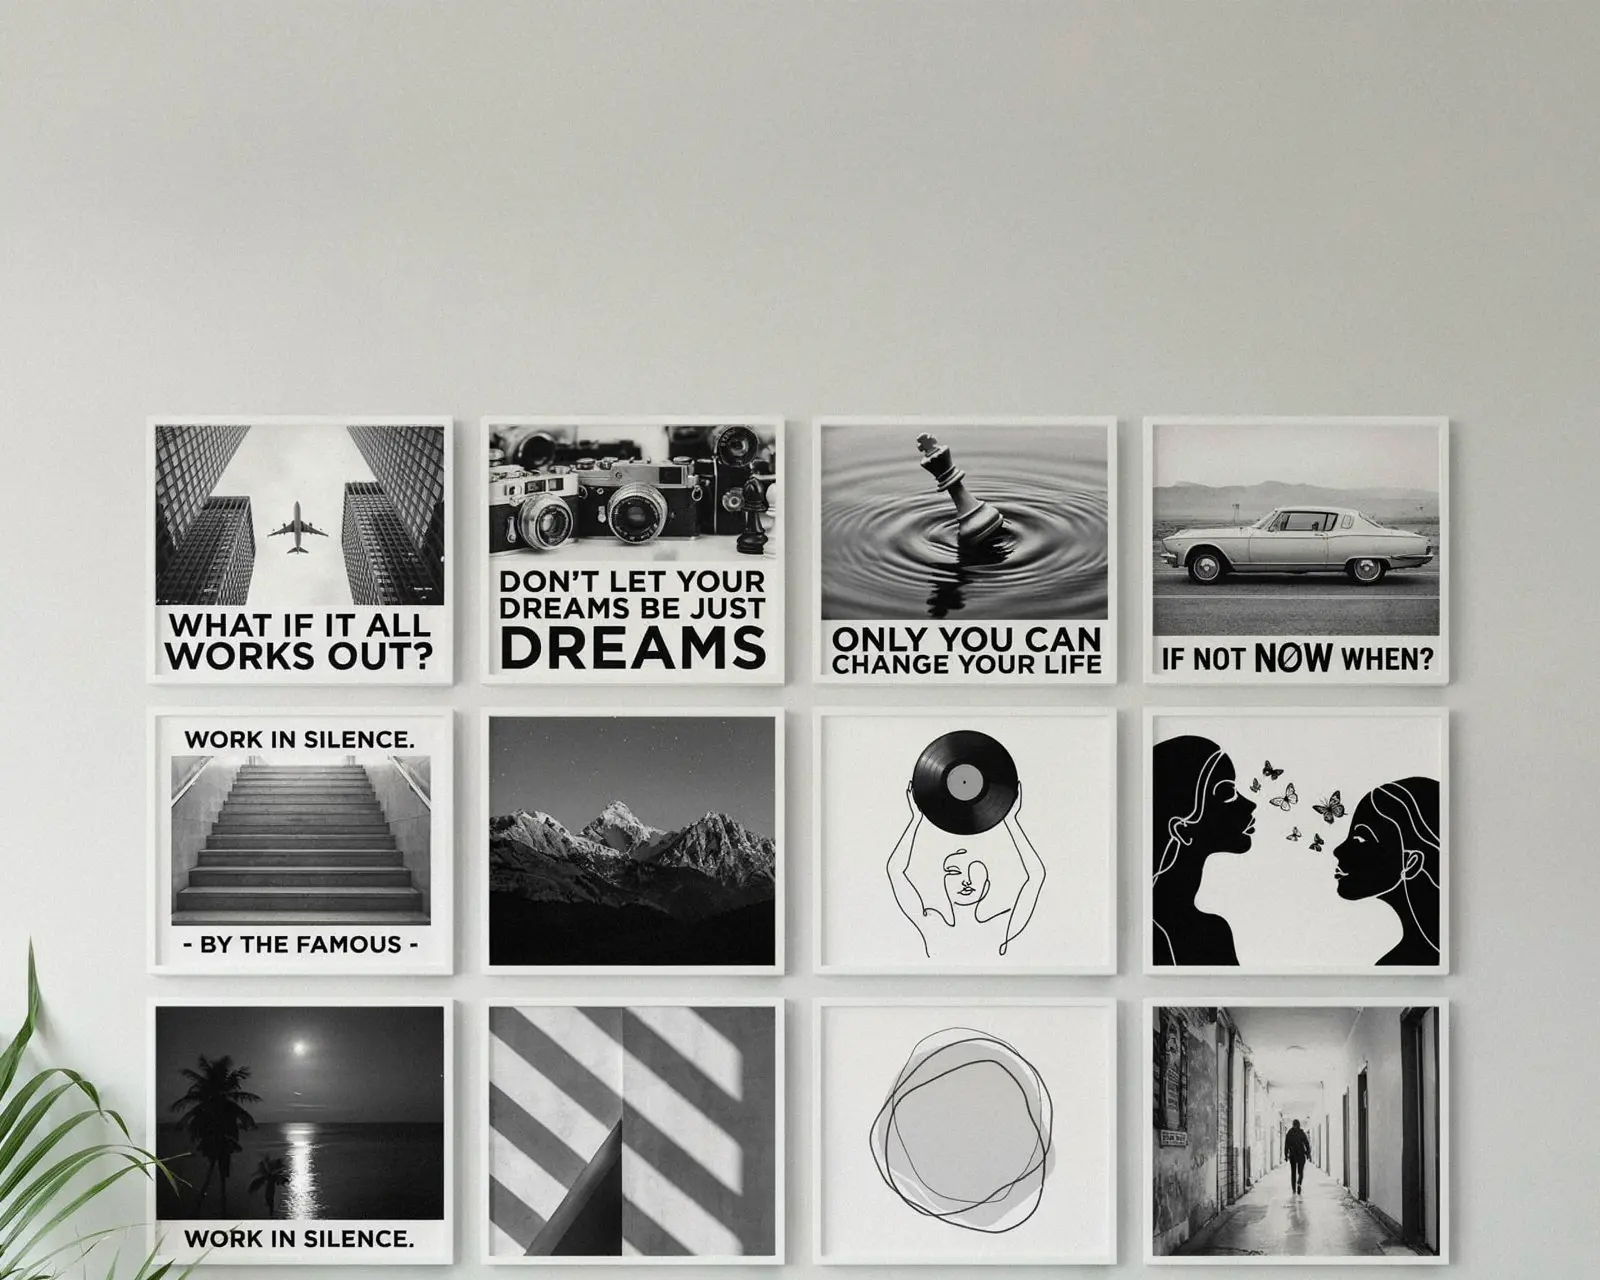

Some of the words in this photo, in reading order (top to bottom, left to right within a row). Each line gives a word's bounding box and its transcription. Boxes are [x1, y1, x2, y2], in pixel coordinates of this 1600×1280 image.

[611, 570, 666, 593] LET
[677, 570, 765, 593] YOUR
[500, 598, 629, 620] DREAMS
[642, 598, 679, 620] BE
[690, 598, 766, 620] JUST
[169, 614, 272, 637] WHAT
[285, 614, 313, 637] IF
[327, 614, 355, 637] IT
[366, 614, 430, 637] ALL
[502, 625, 767, 670] DREAMS
[832, 626, 928, 653] ONLY
[939, 626, 1012, 653] YOU
[1026, 626, 1101, 653] CAN
[164, 641, 314, 671] WORKS
[328, 641, 433, 671] OUT?
[832, 655, 949, 675] CHANGE
[958, 655, 1035, 675] YOUR
[1046, 655, 1102, 675] LIFE
[1162, 647, 1185, 671] IF
[1194, 647, 1246, 671] NOT
[1341, 647, 1434, 671] WHEN?
[185, 731, 262, 749] WORK
[272, 731, 295, 749] IN
[304, 731, 415, 749] SILENCE.
[201, 936, 232, 954] BY
[240, 936, 289, 954] THE
[298, 936, 402, 954] FAMOUS
[184, 1230, 263, 1248] WORK
[271, 1230, 296, 1248] IN
[304, 1230, 414, 1248] SILENCE.
